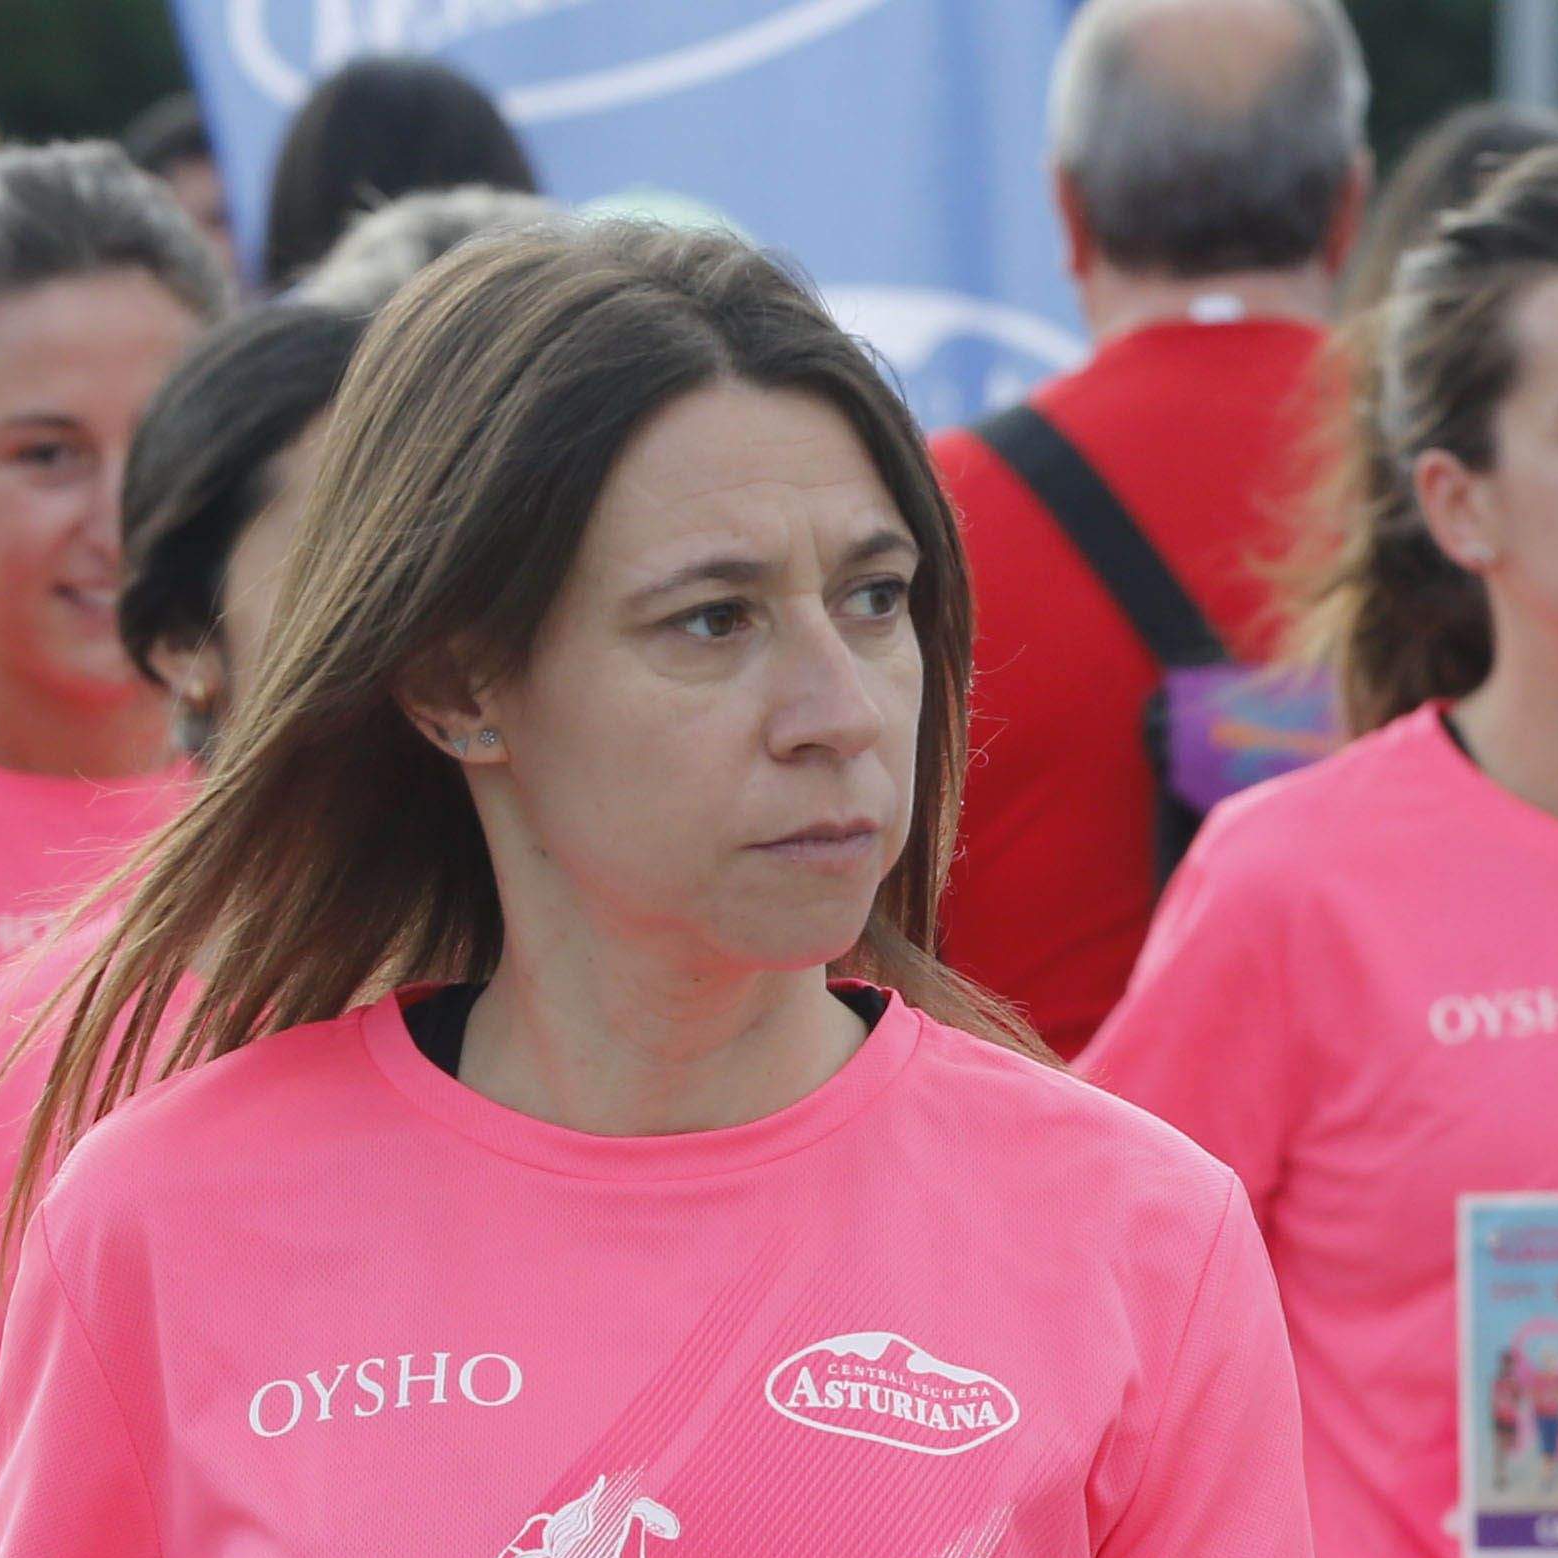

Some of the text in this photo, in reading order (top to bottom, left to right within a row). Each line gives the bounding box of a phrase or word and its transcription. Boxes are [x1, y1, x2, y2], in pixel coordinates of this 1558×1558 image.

[248, 1351, 523, 1438] OYSHO
[786, 1366, 1001, 1431] ASTURIANA
[827, 1362, 991, 1400] CENTRAL LECHERA
